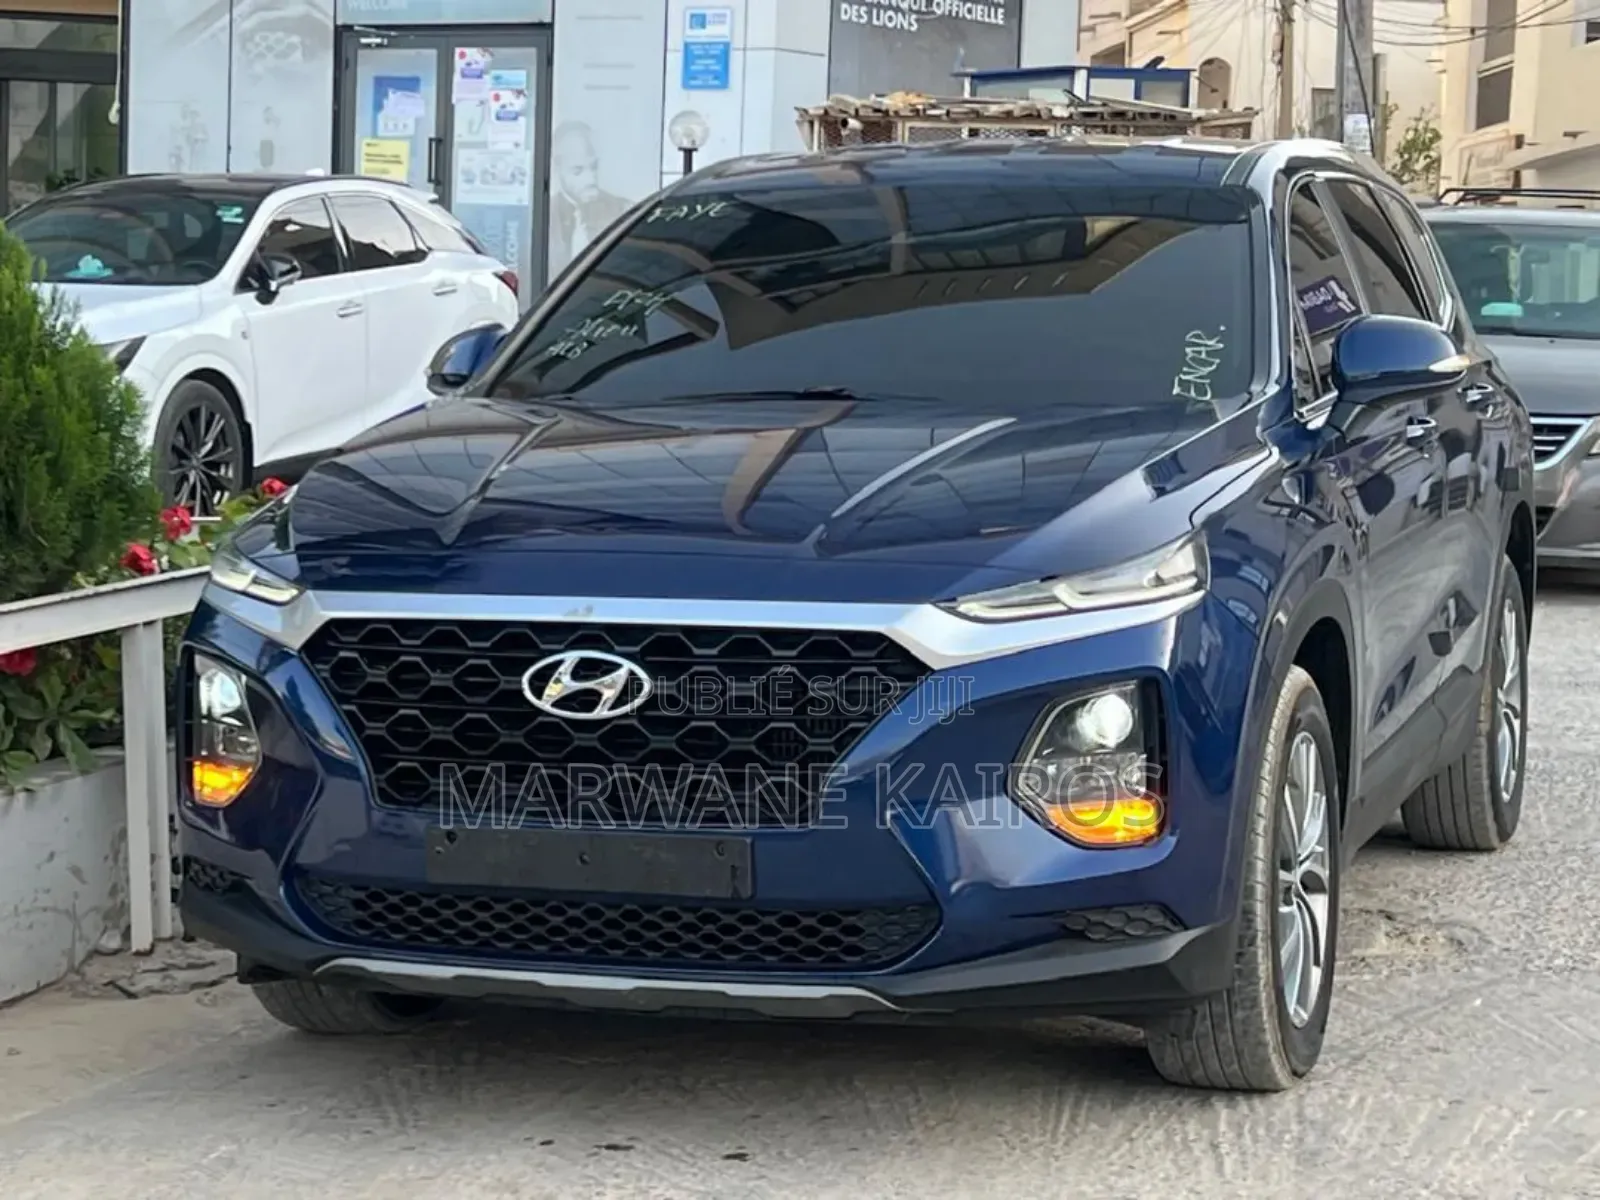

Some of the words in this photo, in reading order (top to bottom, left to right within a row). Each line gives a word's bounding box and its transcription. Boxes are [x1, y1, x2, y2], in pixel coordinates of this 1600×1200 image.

[839, 3, 868, 24] DES
[871, 8, 919, 32] LIONS
[932, 0, 1006, 25] OFFICIELLE
